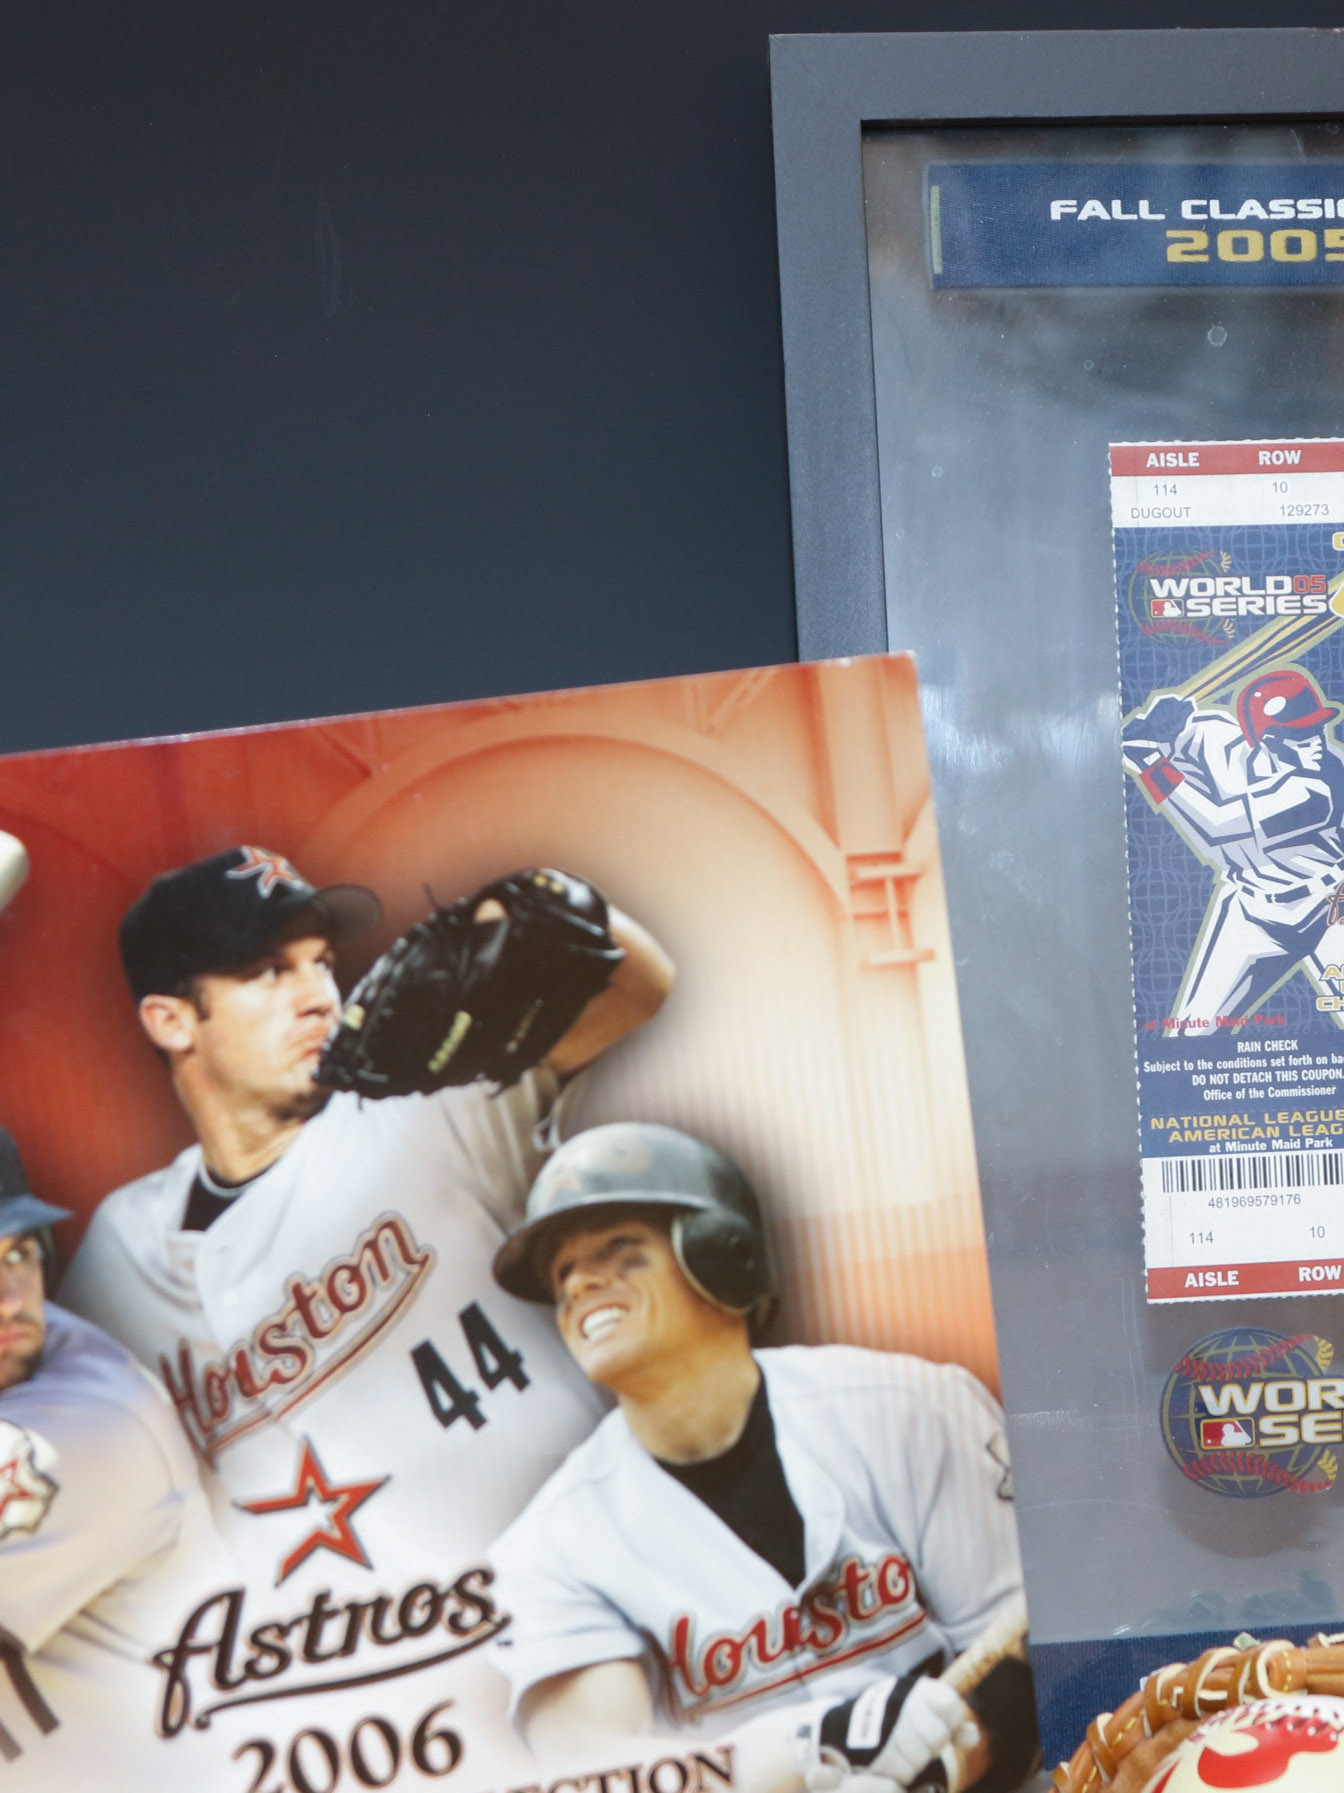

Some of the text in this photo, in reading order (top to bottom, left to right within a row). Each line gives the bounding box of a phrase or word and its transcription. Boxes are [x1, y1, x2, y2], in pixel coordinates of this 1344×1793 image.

[1050, 198, 1166, 221] FALL
[1146, 452, 1200, 468] AISLE
[1258, 449, 1302, 465] ROW
[1152, 484, 1178, 497] 114
[1271, 481, 1289, 494] 10
[1130, 506, 1192, 520] DUGOUT
[1279, 503, 1330, 517] 129273
[1150, 573, 1327, 599] WORLD 05
[1186, 594, 1329, 618] SERIES
[1162, 1012, 1286, 1029] Minute Maid Park
[1237, 1039, 1298, 1053] RAIN CHECK
[1143, 1060, 1181, 1073] Subject
[1183, 1060, 1194, 1070] to
[1197, 1058, 1214, 1069] the
[1216, 1057, 1268, 1069] conditions
[1270, 1056, 1286, 1067] set
[1288, 1054, 1313, 1066] forth
[1192, 1074, 1207, 1086] DO
[1209, 1073, 1231, 1085] NOT
[1233, 1071, 1273, 1084] DETACH
[1275, 1069, 1298, 1082] THIS
[1203, 1084, 1337, 1101] Office the Commissioner
[1150, 1113, 1252, 1130] NATIONAL
[1168, 1126, 1281, 1143] AMERICAN
[1209, 1136, 1333, 1153] at Minute Maid Park
[1207, 1193, 1302, 1209] 481969579176
[1188, 1231, 1214, 1245] 114
[1310, 1225, 1326, 1239] 10
[1184, 1270, 1239, 1288] AISLE
[1298, 1265, 1342, 1282] ROW
[410, 1300, 532, 1431] 44
[668, 1553, 925, 1712] ousto
[151, 1565, 510, 1739] Astros
[232, 1699, 466, 1793] 2006
